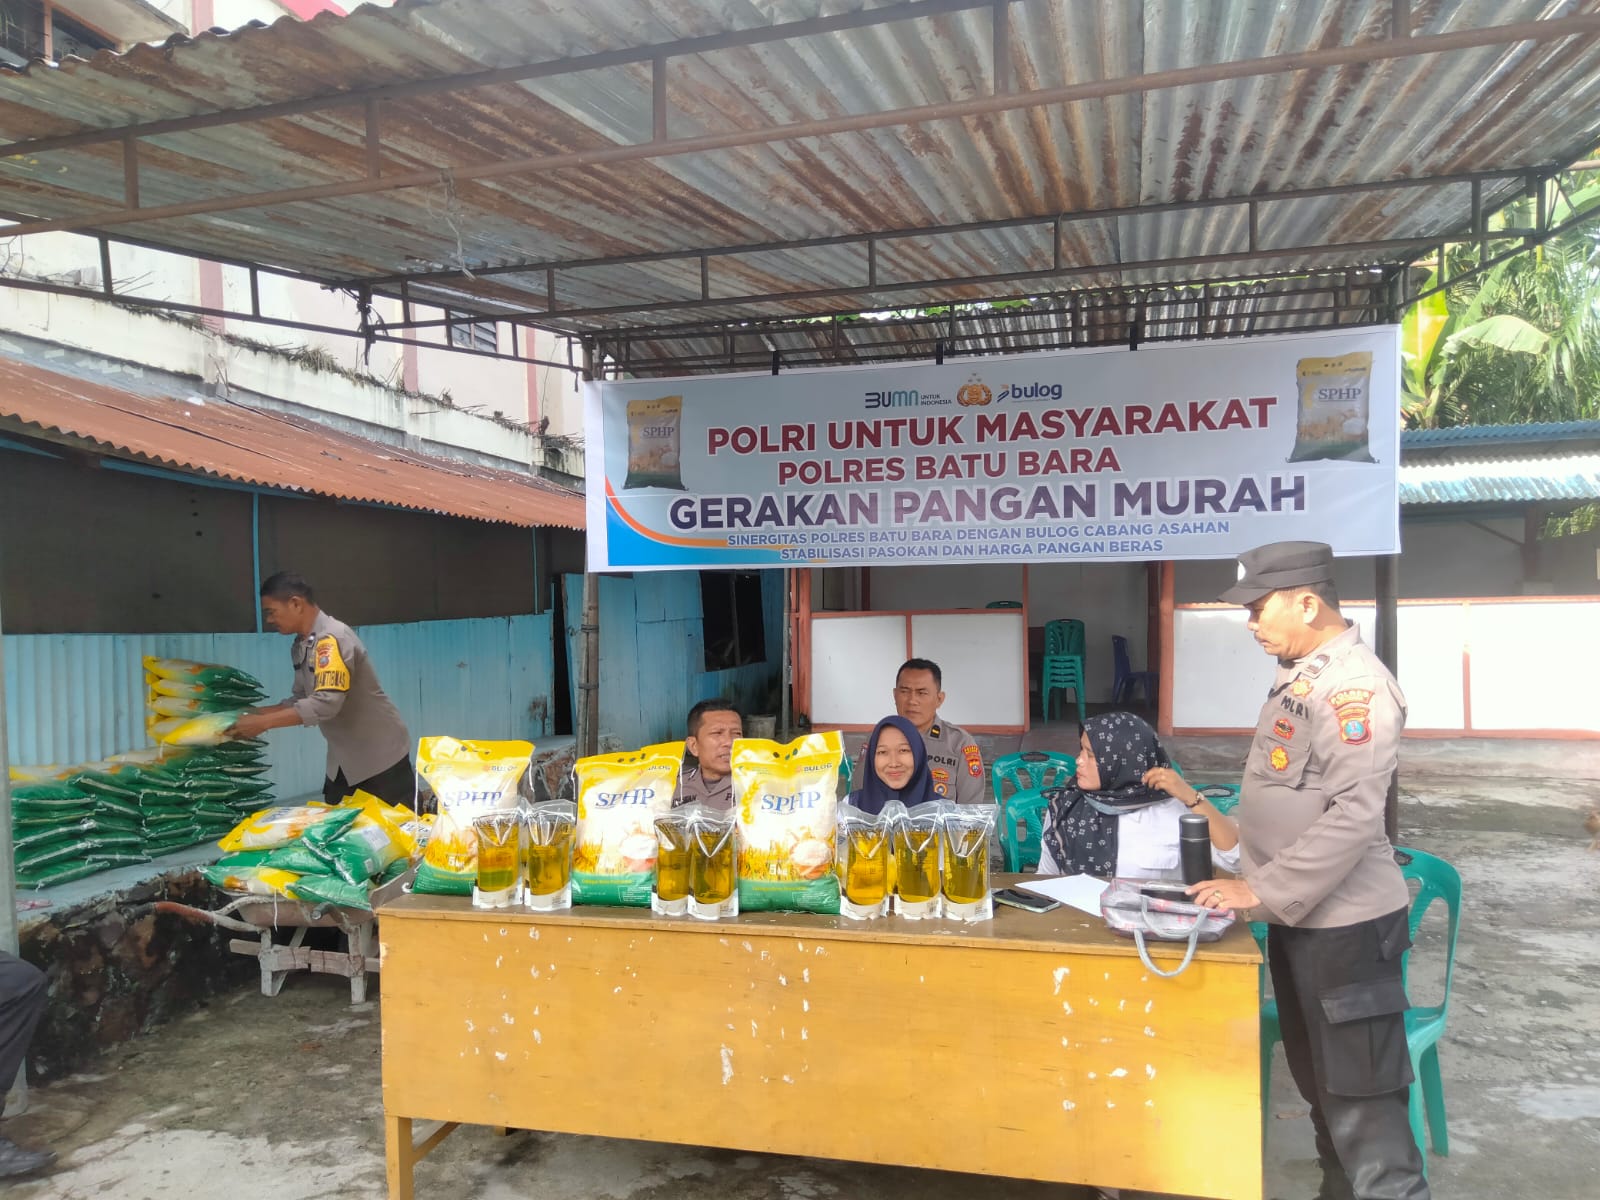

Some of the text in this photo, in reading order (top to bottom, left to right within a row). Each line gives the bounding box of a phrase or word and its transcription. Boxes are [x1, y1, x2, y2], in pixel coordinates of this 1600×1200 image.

[1318, 387, 1362, 400] SPHP
[643, 426, 675, 437] SPHP
[708, 397, 1277, 454] POLRI UNTUK MASYARAKAT
[779, 447, 1121, 485] POLRES BATU BARA
[670, 475, 1305, 530] GERAKAN PANGAN MURAH
[728, 521, 1229, 545] SINERGITAS POLRES BATU BARA DENGAN BULOG CABANG ASAHAN
[781, 540, 1163, 560] STABILISASI PASOKAN DAN HARGA PANGAN BERAS
[927, 754, 956, 766] POLRI
[761, 791, 821, 811] SPHP
